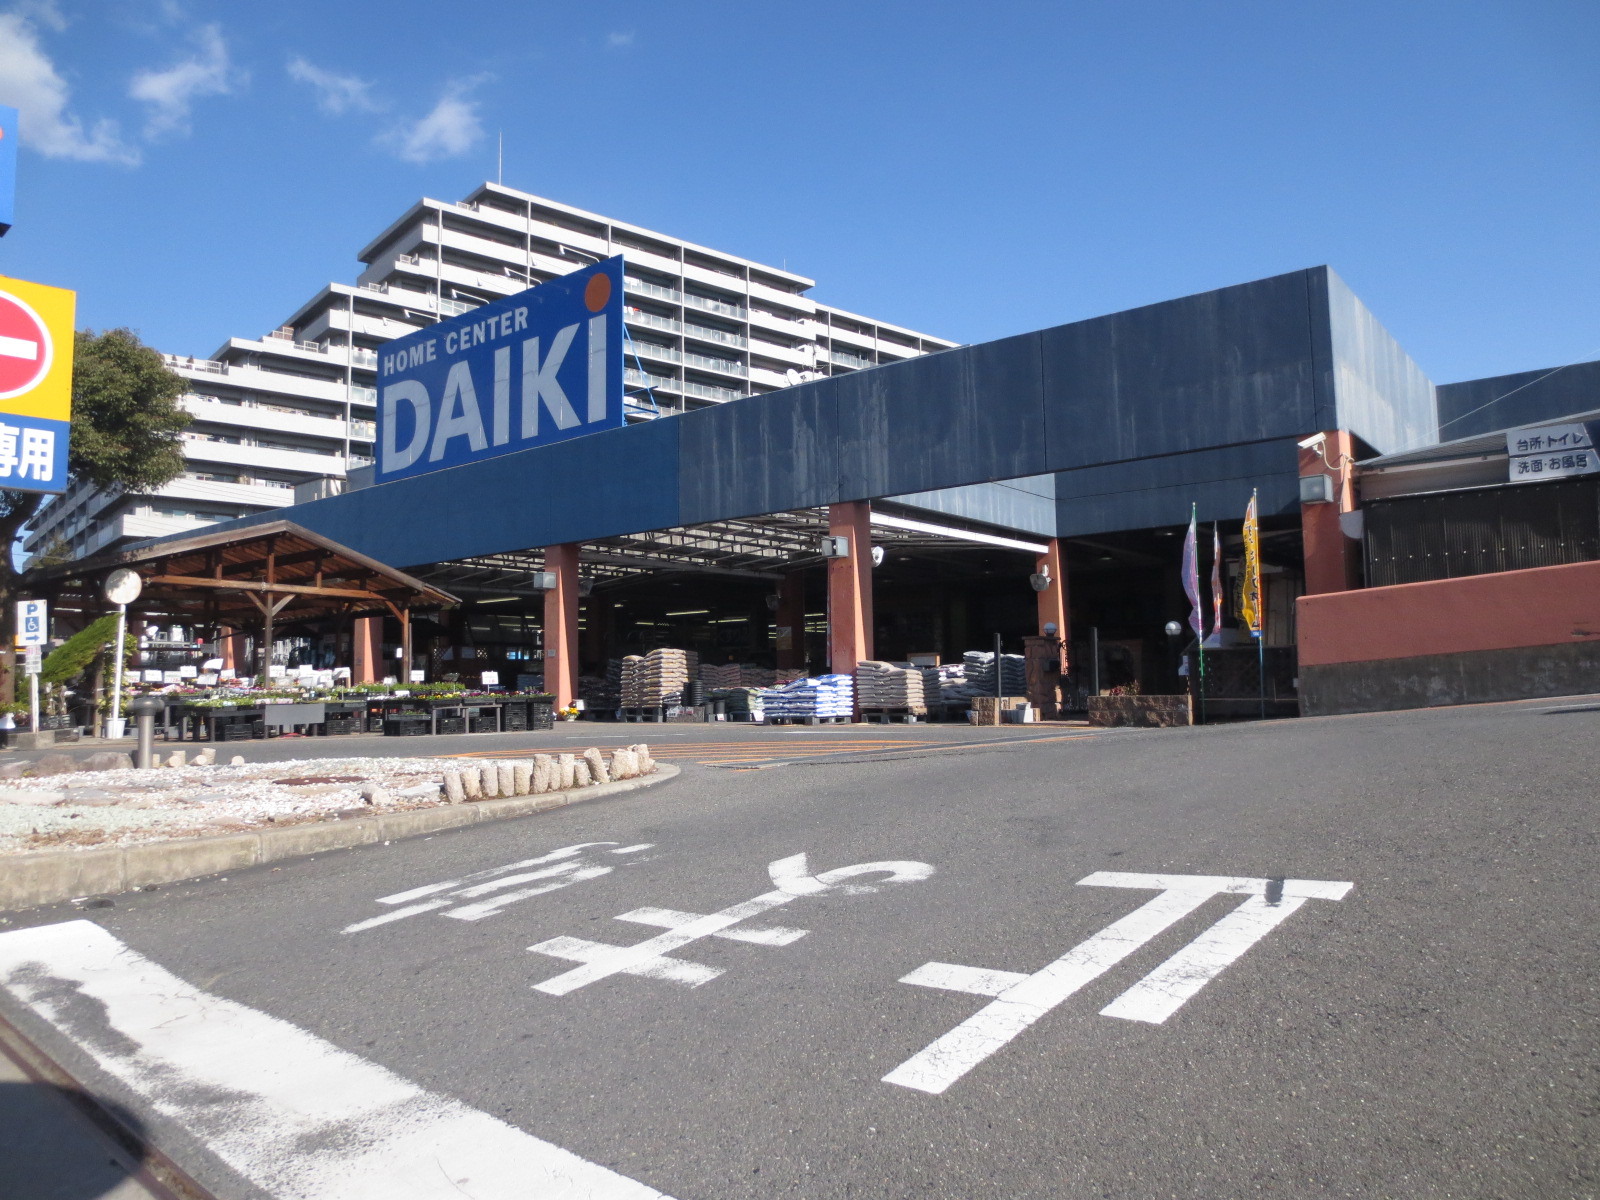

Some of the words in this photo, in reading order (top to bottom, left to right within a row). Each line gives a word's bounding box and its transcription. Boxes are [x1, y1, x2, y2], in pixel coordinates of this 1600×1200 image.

[383, 338, 437, 377] HOME
[445, 306, 529, 355] CENTER
[26, 603, 39, 616] P
